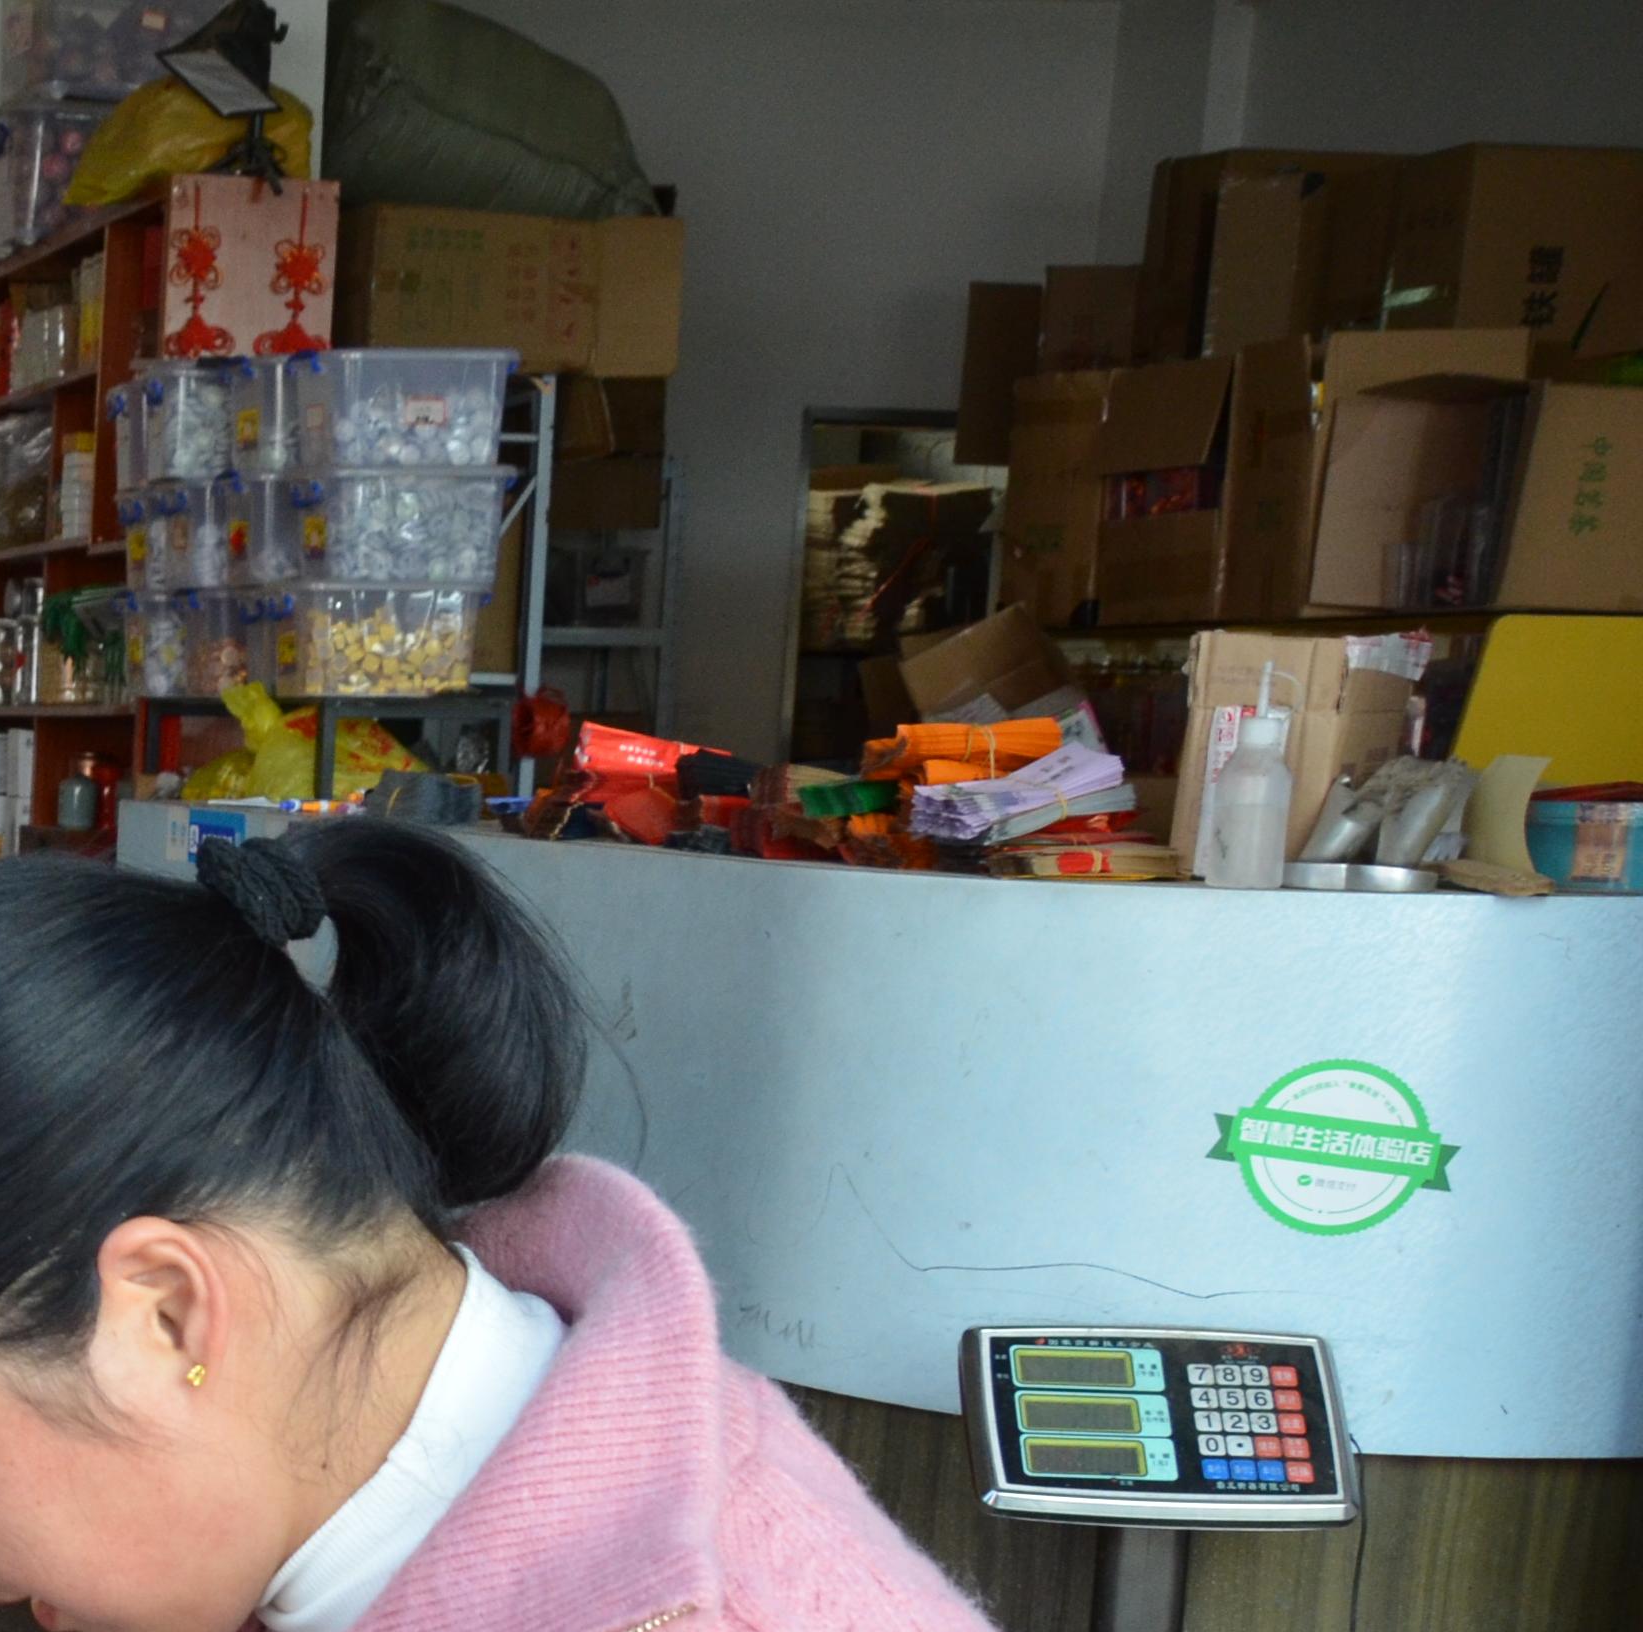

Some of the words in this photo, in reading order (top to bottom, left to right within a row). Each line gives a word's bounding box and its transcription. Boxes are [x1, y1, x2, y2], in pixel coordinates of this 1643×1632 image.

[1238, 1116, 1434, 1167] 智慧生活体验店
[1194, 1367, 1207, 1382] 7
[1222, 1367, 1236, 1382] 8
[1250, 1368, 1264, 1382] 9
[1199, 1391, 1211, 1405] 4
[1226, 1391, 1240, 1406] 5
[1254, 1392, 1268, 1407] 6
[1202, 1415, 1213, 1429] 1
[1229, 1415, 1244, 1429] 2
[1257, 1415, 1271, 1430] 3
[1205, 1437, 1219, 1452] 0
